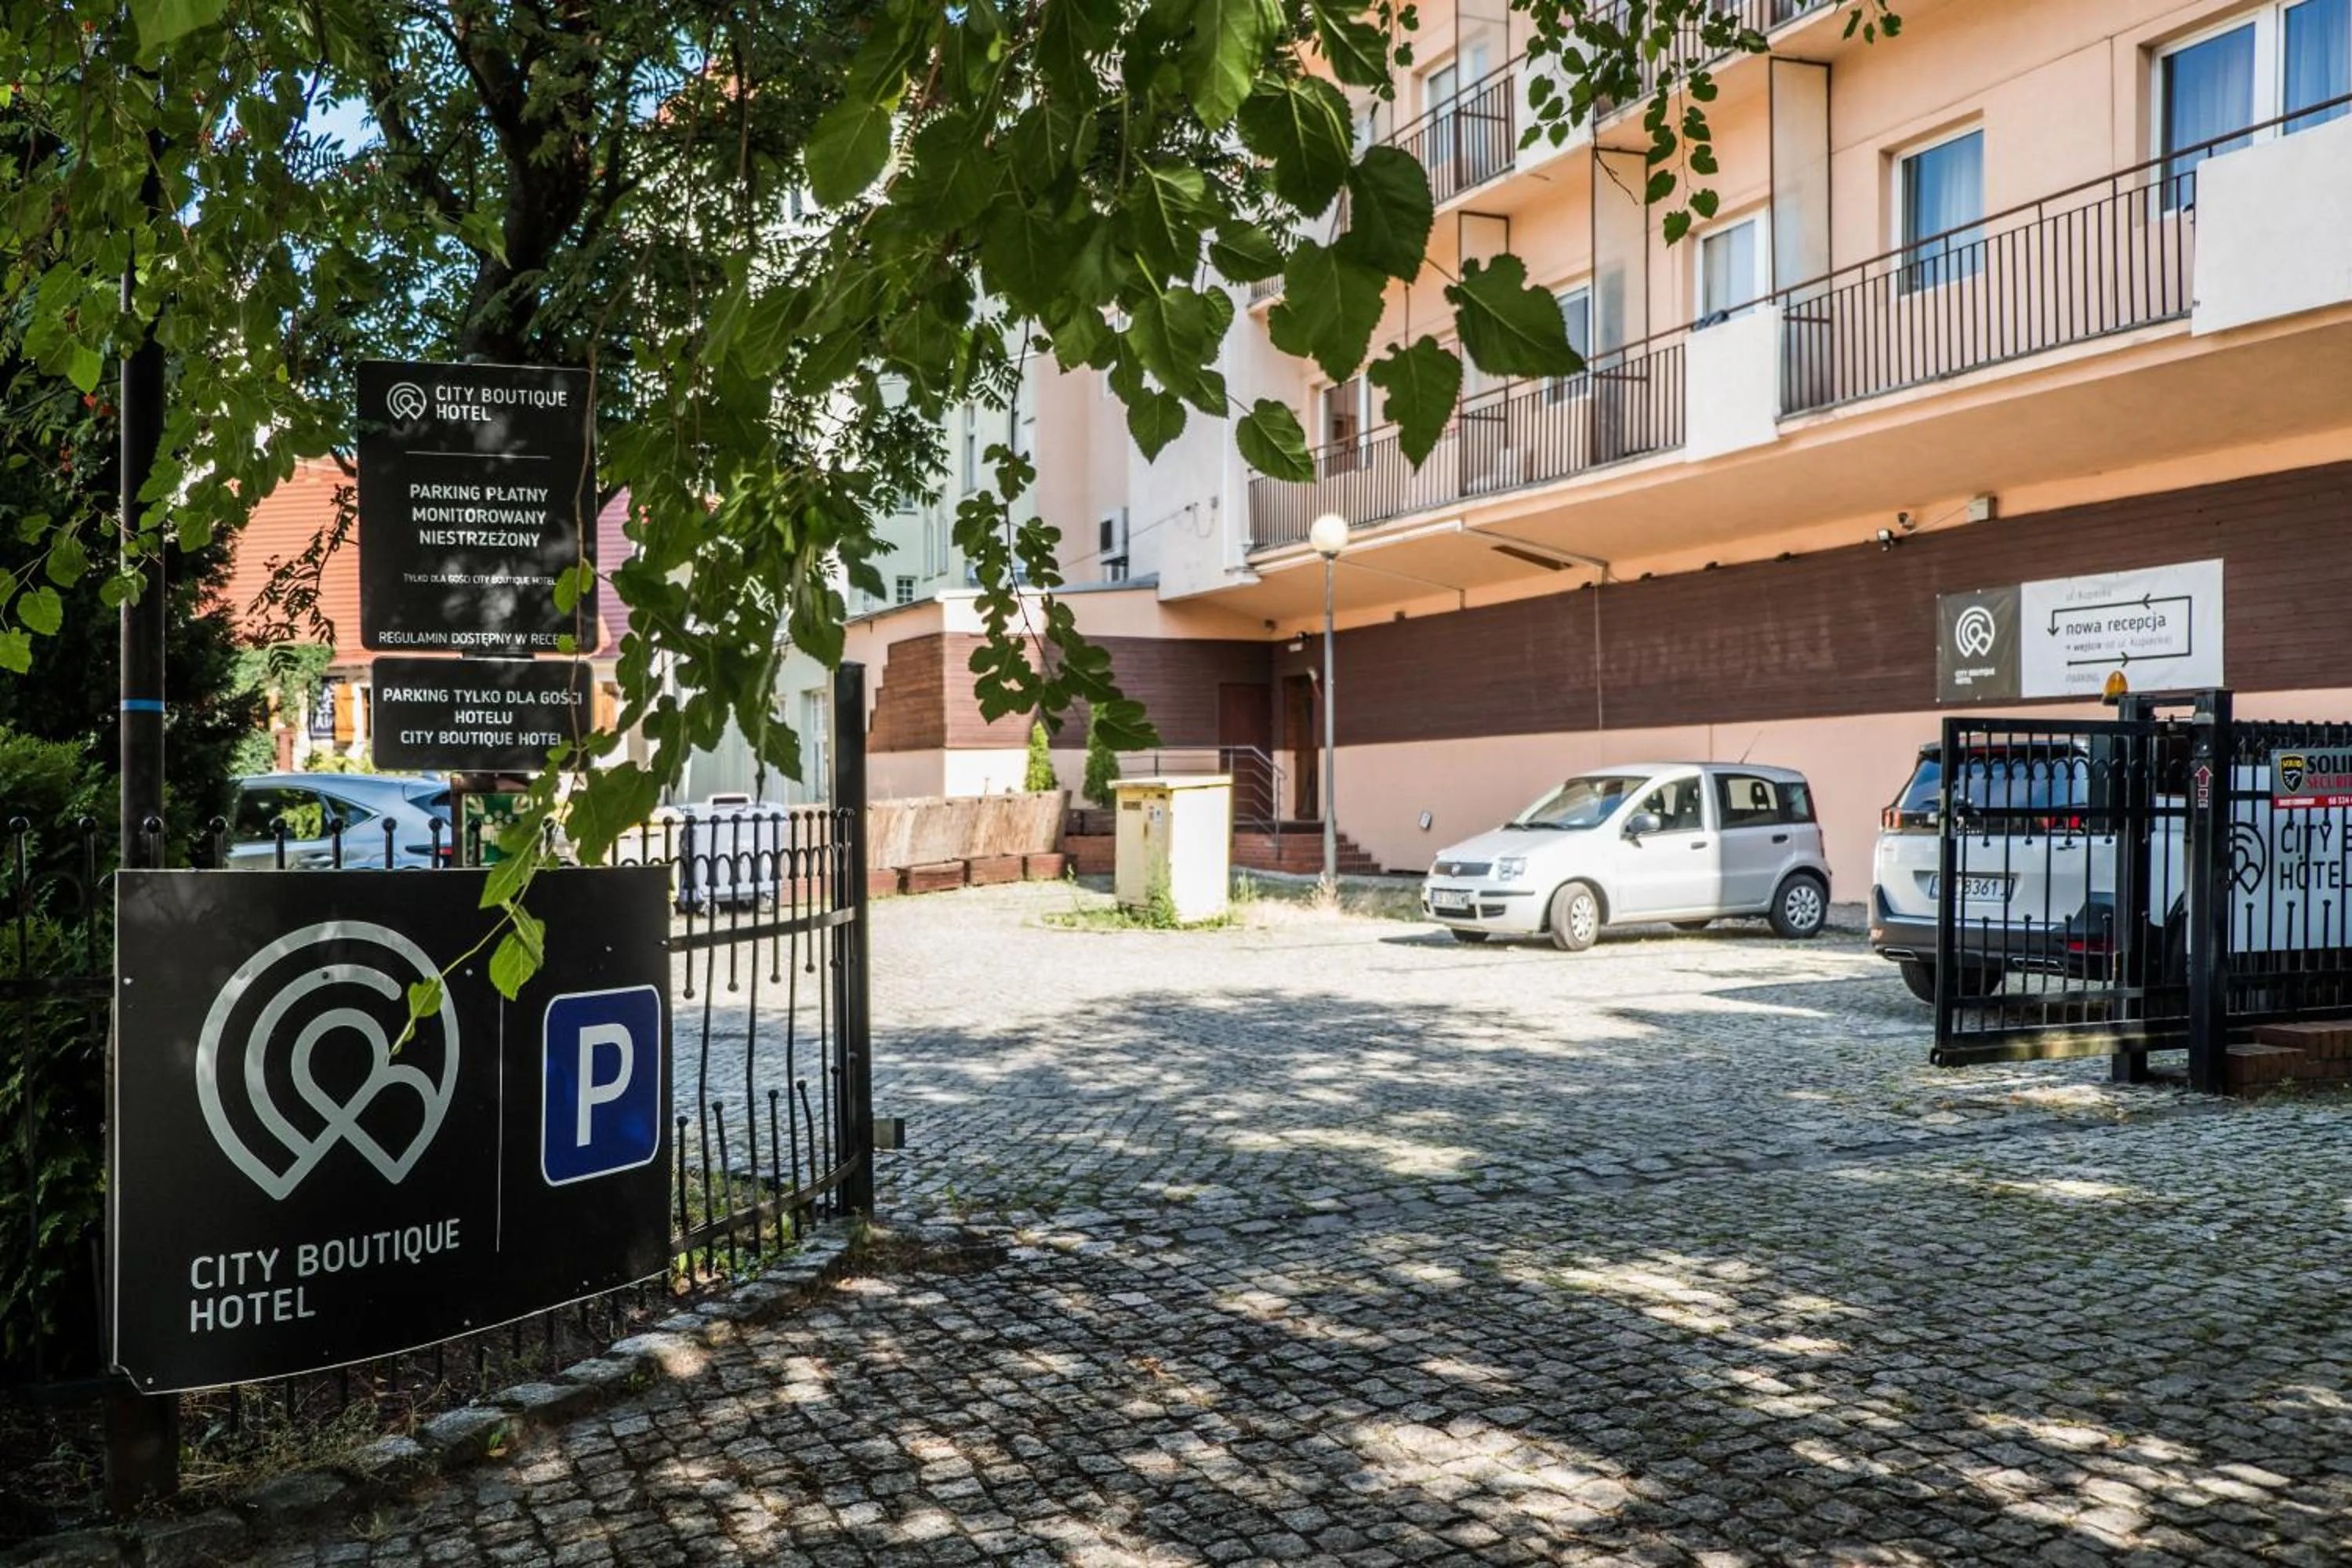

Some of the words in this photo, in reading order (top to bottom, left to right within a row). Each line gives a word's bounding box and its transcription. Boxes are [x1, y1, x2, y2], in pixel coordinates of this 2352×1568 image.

[435, 385, 474, 402] CITY
[481, 388, 568, 408] BOUTIQUE
[436, 404, 492, 421] HOTEL
[410, 483, 481, 501] PARKING
[485, 486, 548, 503] PŁATNY
[412, 506, 546, 525] MONITOROWANY
[419, 529, 540, 548] NIESTRZEŻONY
[473, 575, 489, 584] CITY
[491, 575, 530, 586] BOUTIQUE
[2066, 620, 2102, 636] nowa
[2107, 612, 2166, 633] recepcja
[379, 631, 448, 644] REGULAMIN
[451, 633, 512, 646] DOSTĘPNY
[515, 633, 527, 644] W
[383, 688, 448, 702] PARKING
[454, 690, 501, 703] TYLKO
[506, 691, 535, 704] DLA
[540, 688, 583, 705] GOŚCI
[455, 710, 514, 724] HOTELU
[401, 730, 434, 744] CITY
[439, 731, 514, 747] BOUTIQUE
[2281, 823, 2333, 854] CITY
[576, 1022, 634, 1148] P
[191, 1247, 280, 1290] CITY
[298, 1218, 461, 1278] BOUTIQUE
[191, 1286, 316, 1334] HOTEL
